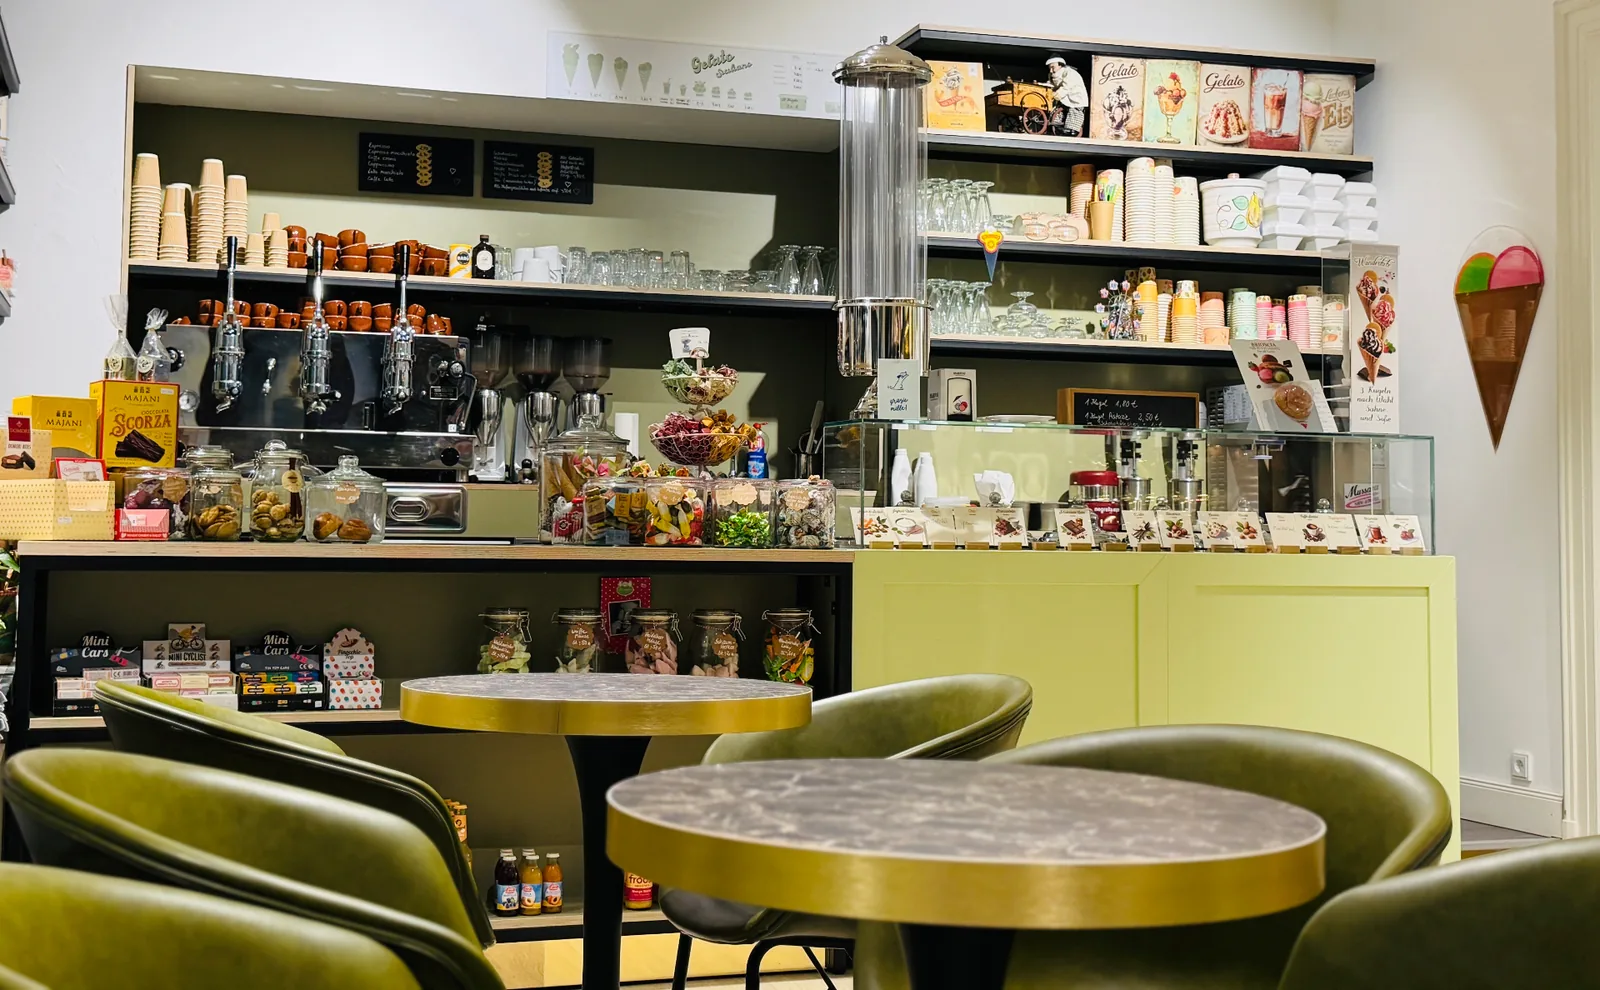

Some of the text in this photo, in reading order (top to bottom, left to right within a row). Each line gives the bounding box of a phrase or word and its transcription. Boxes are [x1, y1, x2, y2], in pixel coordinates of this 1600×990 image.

[691, 49, 735, 75] Gelato
[1099, 61, 1140, 85] Gelato
[1204, 73, 1245, 93] Gelato
[1322, 103, 1353, 131] Eis
[124, 395, 160, 403] MAJANI
[46, 419, 82, 427] MAJANI
[82, 635, 110, 647] Mini
[263, 635, 290, 646] Mini
[82, 647, 110, 659] Cars
[168, 652, 206, 662] MINI CYCLIST
[263, 646, 290, 656] Cars
